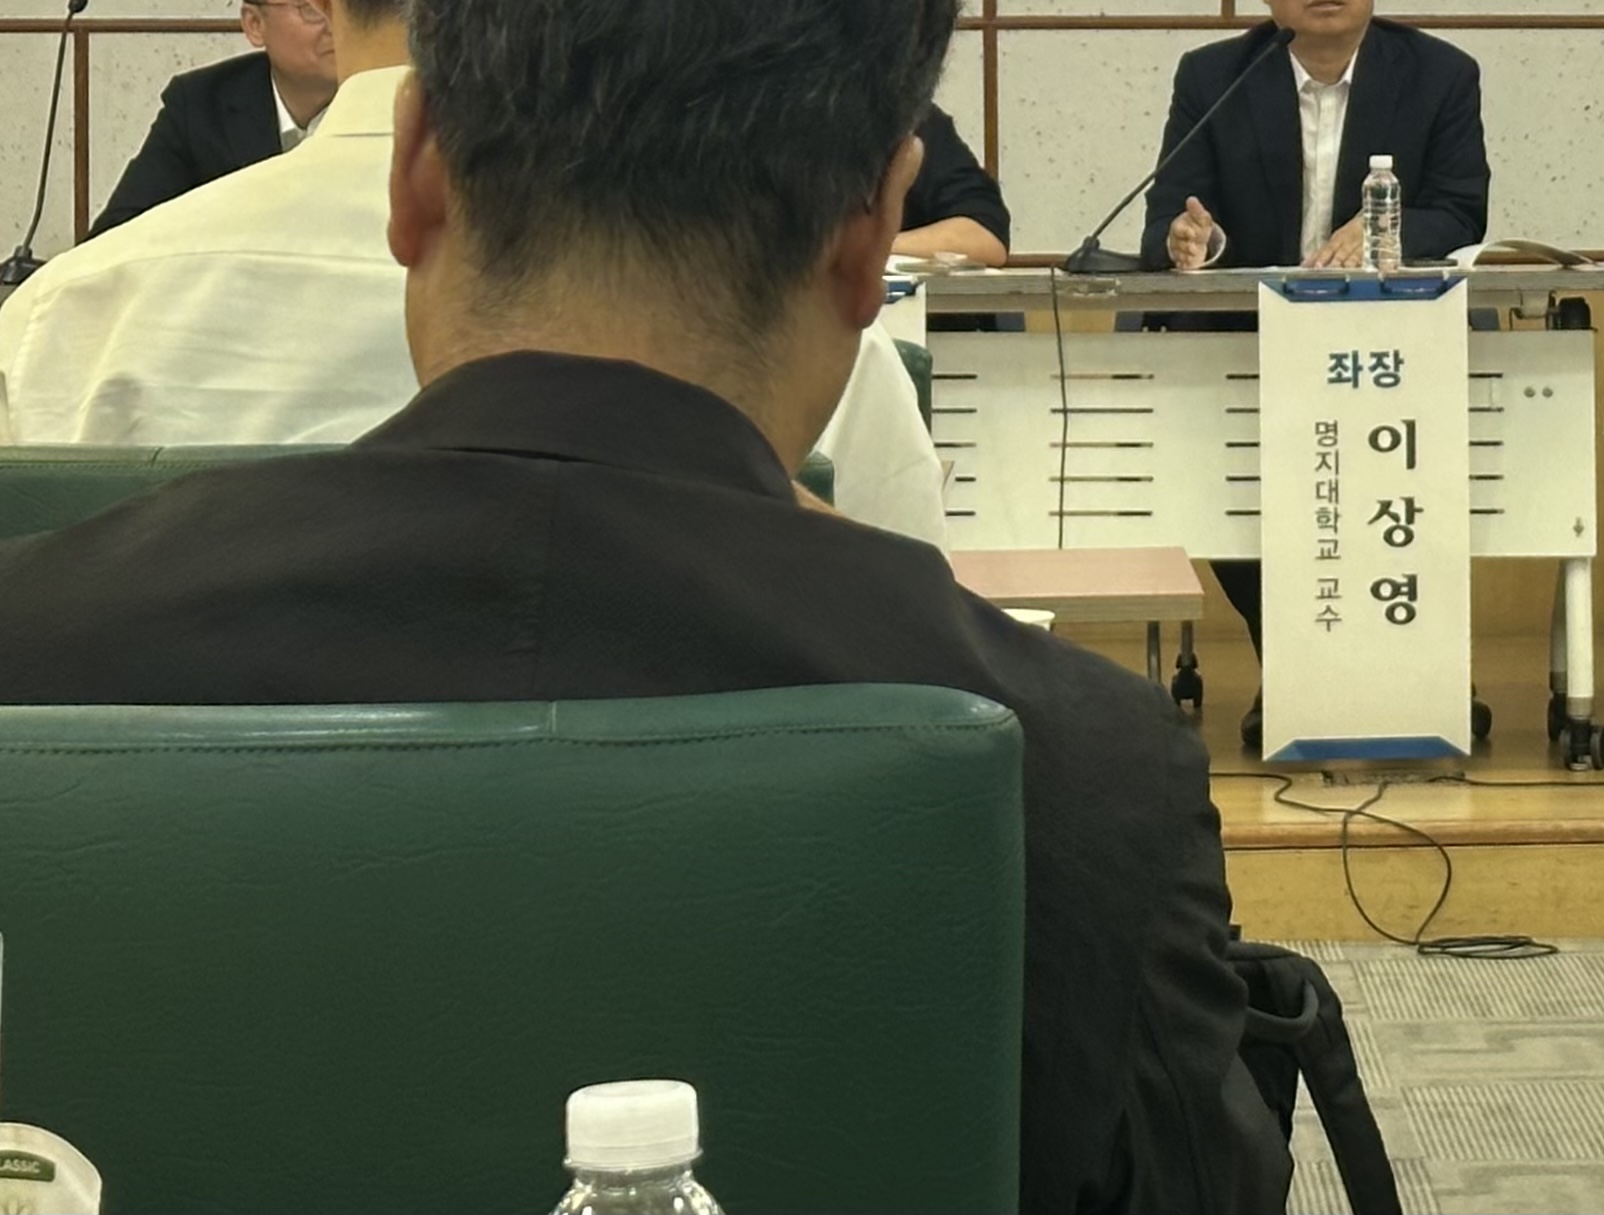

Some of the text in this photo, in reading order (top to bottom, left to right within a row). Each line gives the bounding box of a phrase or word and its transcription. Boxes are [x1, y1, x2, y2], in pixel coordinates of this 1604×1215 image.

[1327, 349, 1405, 389] 좌장
[1313, 419, 1344, 635] 명지대학교 교수
[1368, 419, 1424, 626] 이상영
